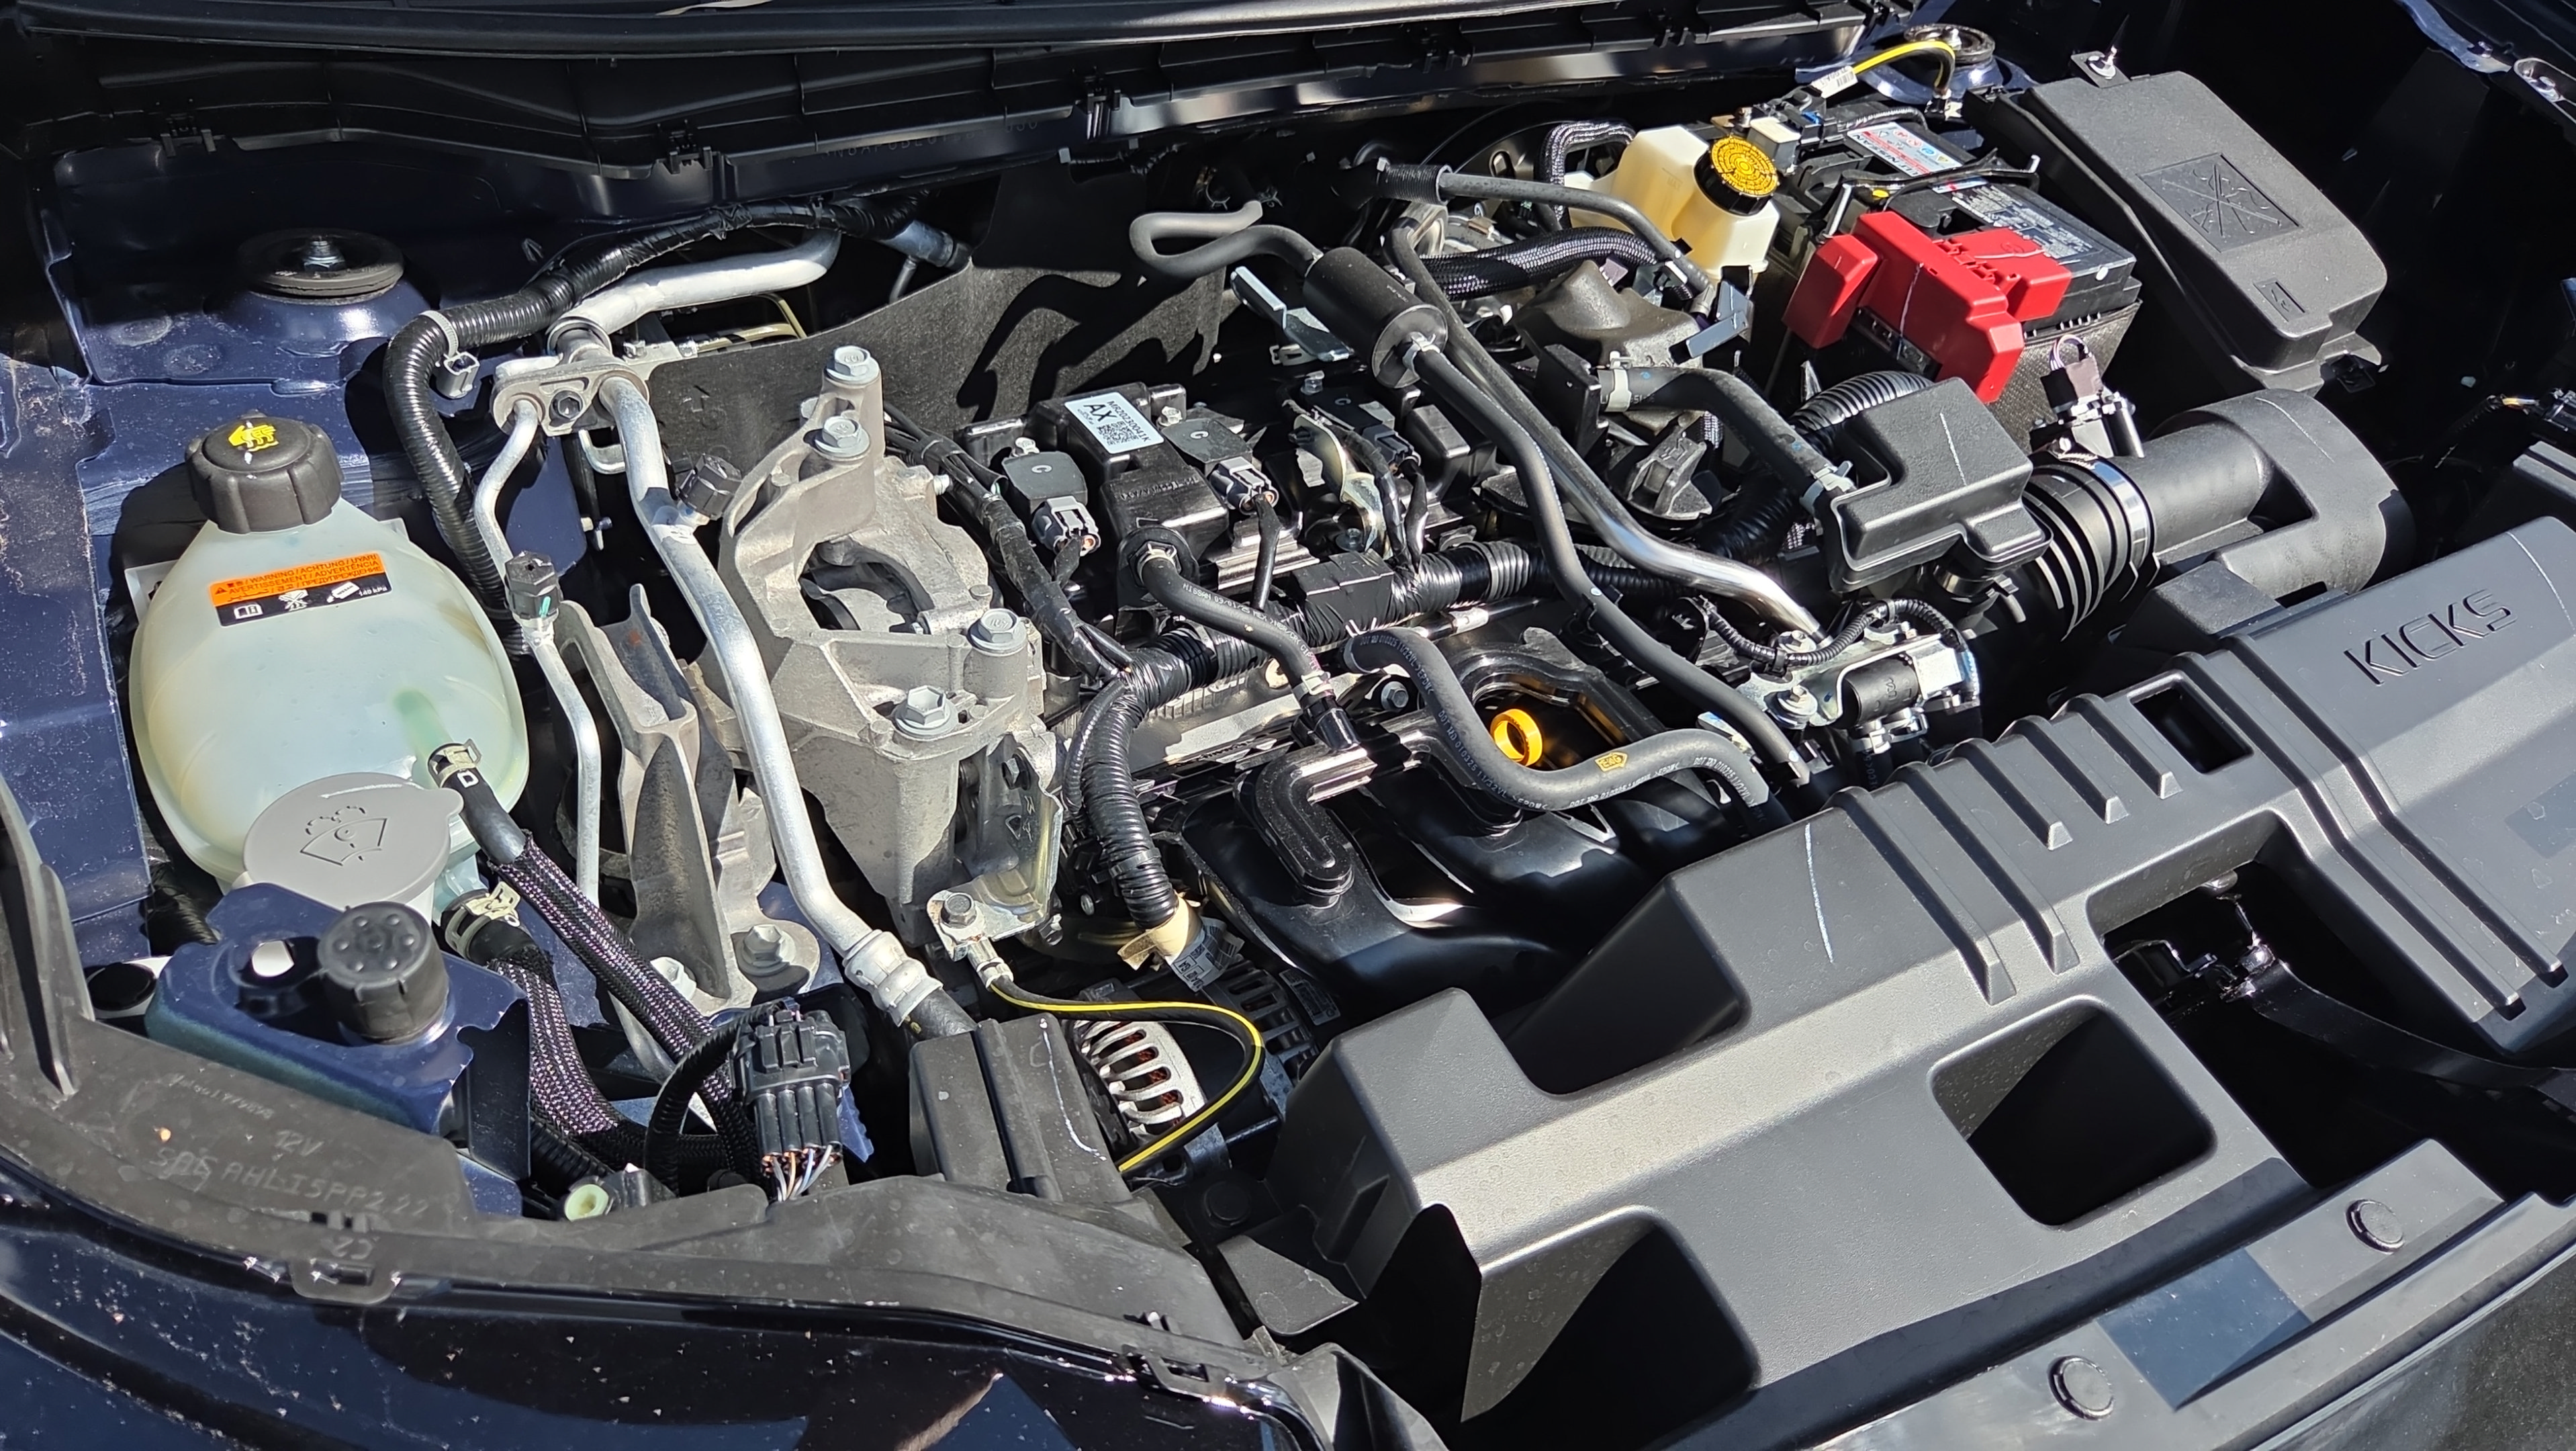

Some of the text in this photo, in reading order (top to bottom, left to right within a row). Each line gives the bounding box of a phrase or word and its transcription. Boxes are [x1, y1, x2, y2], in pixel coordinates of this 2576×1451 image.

[1083, 404, 1117, 422] AX
[229, 574, 308, 594] AVERTISSEMENT
[314, 560, 379, 578] ADVERTÊNCIA
[249, 570, 295, 583] WARNING
[300, 561, 345, 574] ACHTUNG
[302, 566, 383, 586] ПРЕДУПРЕЖДЕНИЕ
[373, 585, 388, 594] kPa
[1183, 582, 1211, 600] NISSAN
[2343, 588, 2518, 686] KICKS
[1438, 710, 1450, 726] DOT
[1455, 742, 1477, 772] 010325
[1599, 755, 1622, 768] ENG
[1569, 799, 1585, 807] DOT
[274, 1129, 324, 1157] 12V
